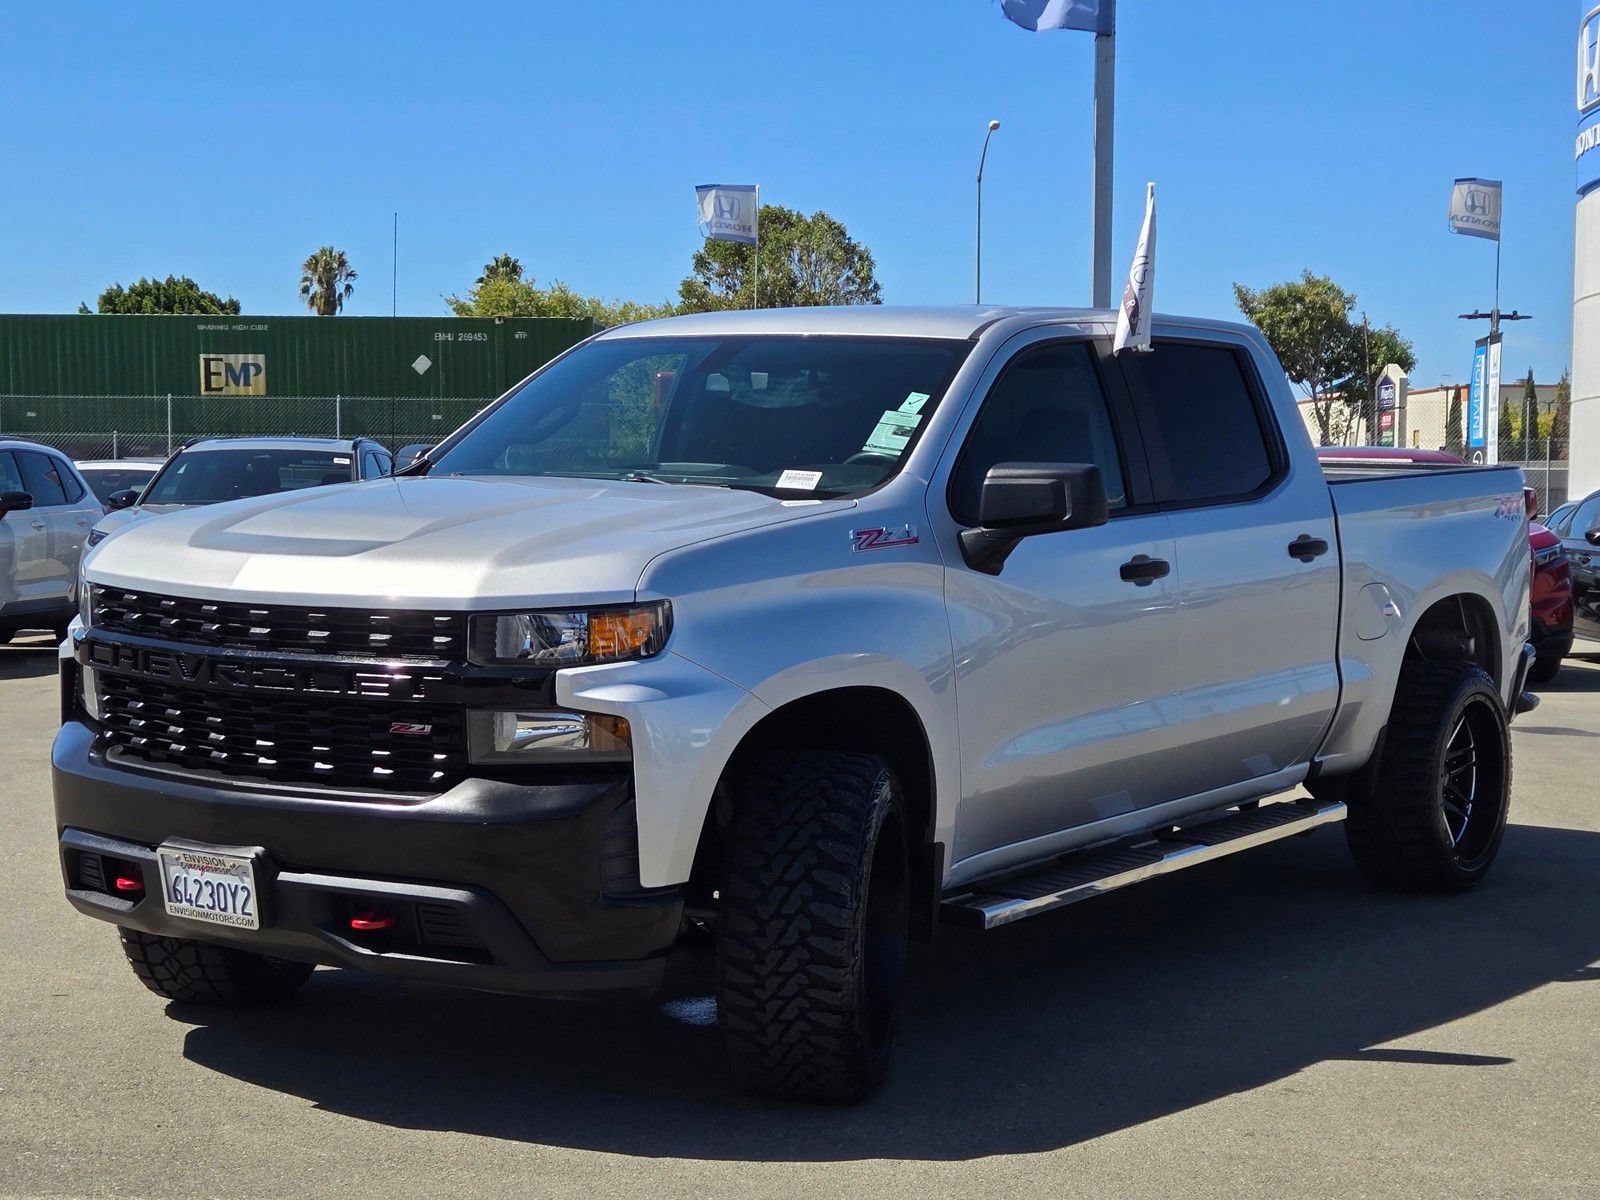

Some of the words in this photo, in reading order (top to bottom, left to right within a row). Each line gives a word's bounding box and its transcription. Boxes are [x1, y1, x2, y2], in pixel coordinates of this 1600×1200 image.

[458, 333, 488, 341] 269453
[203, 357, 262, 392] EMP
[1472, 354, 1483, 440] ENVISION
[89, 641, 443, 699] CHEVROLET
[183, 853, 226, 867] ENVISION
[173, 875, 252, 917] 64230Y2
[169, 905, 255, 928] ENVISIONMOTORS.COM
